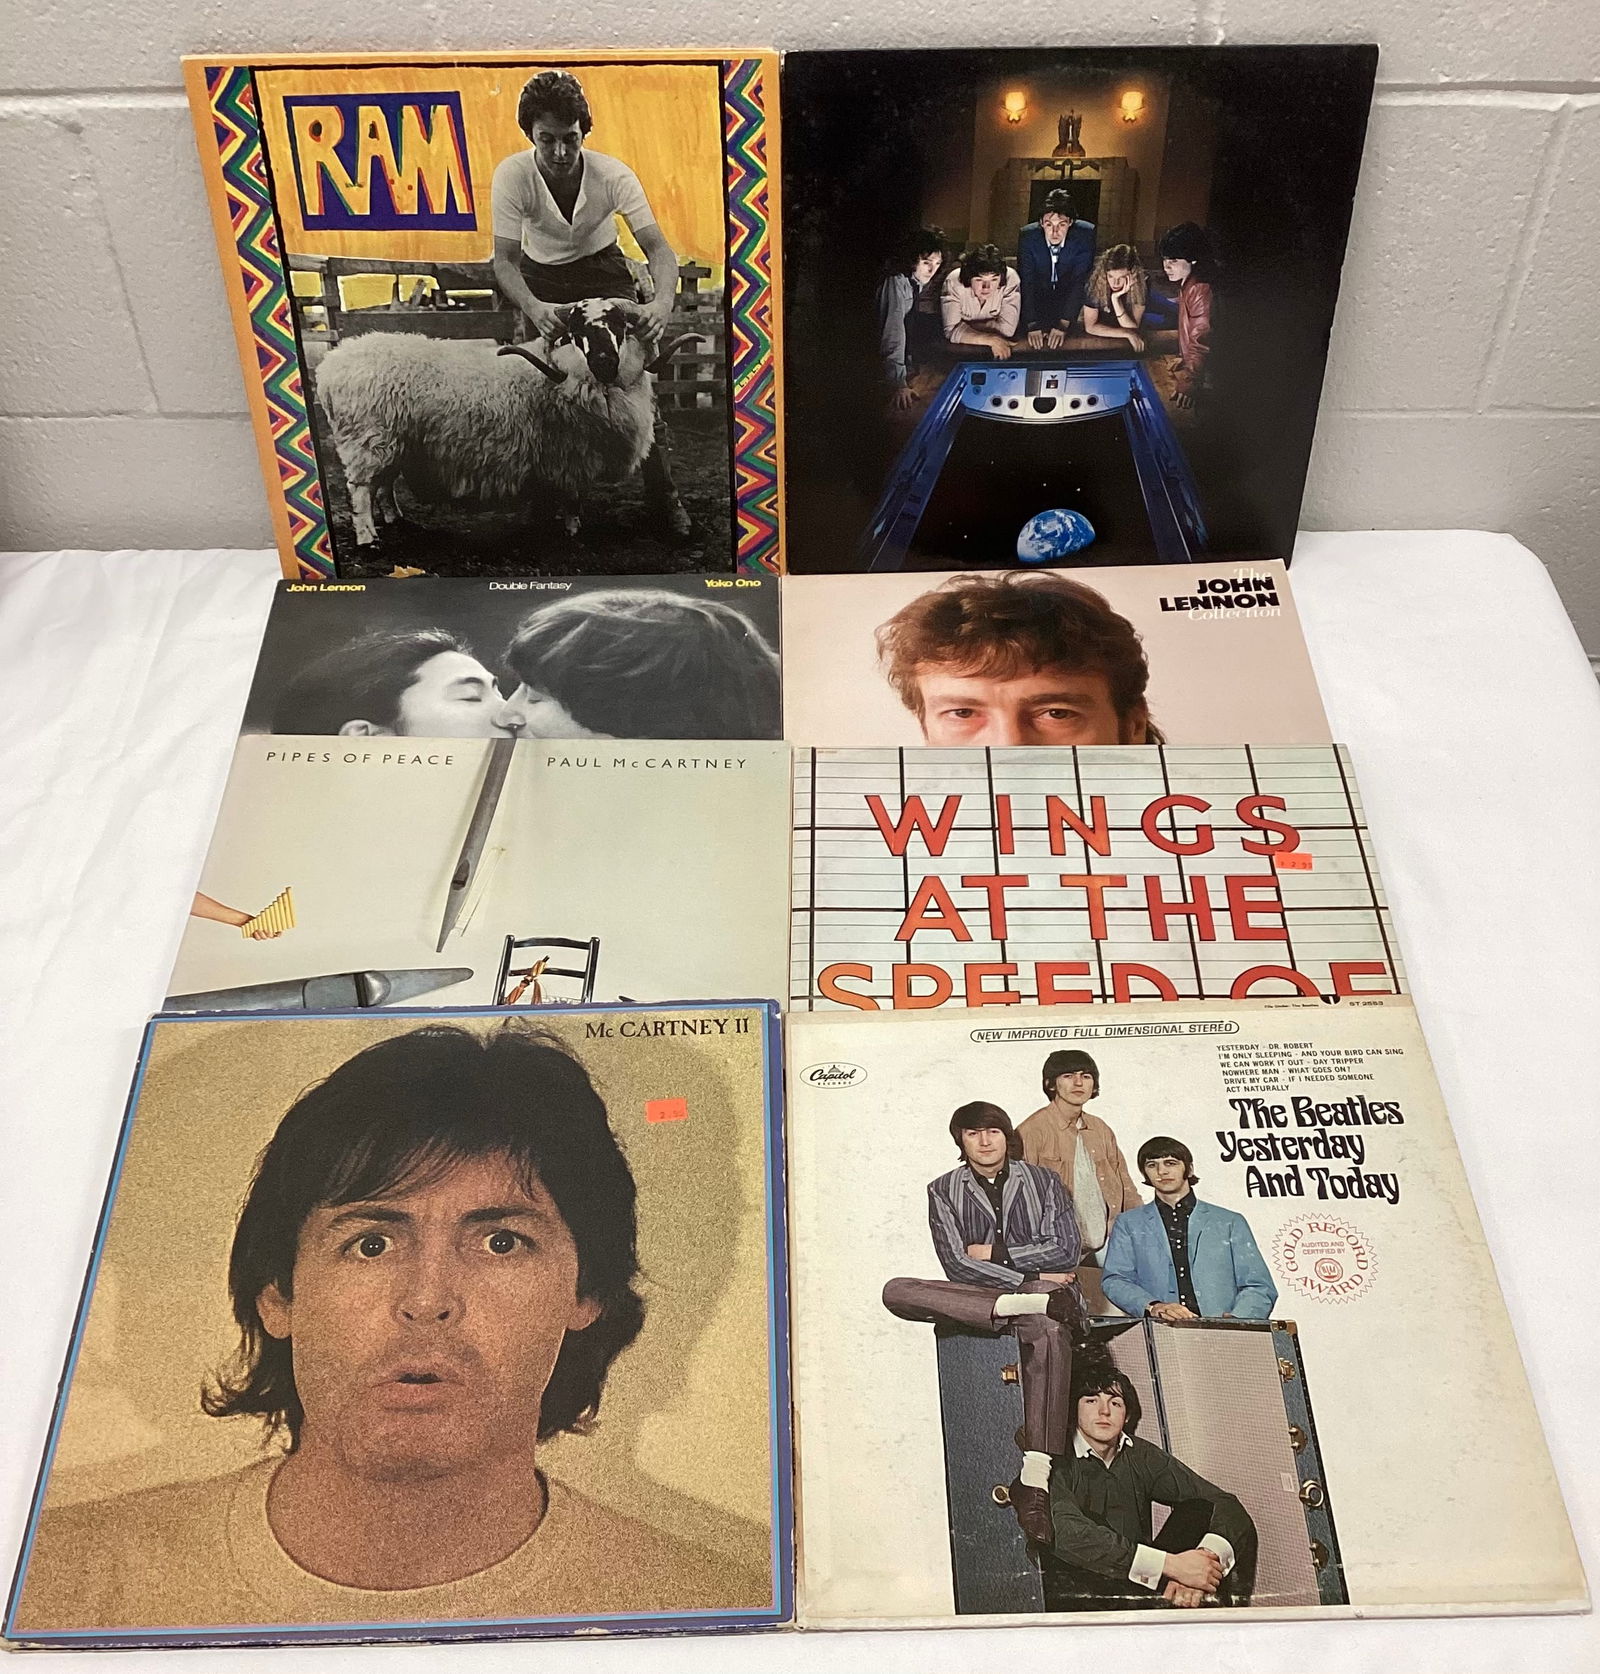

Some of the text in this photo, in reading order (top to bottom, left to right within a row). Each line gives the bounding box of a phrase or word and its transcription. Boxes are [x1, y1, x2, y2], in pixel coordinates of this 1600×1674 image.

[291, 104, 474, 216] RAM
[1233, 567, 1272, 580] The
[286, 583, 366, 592] John Lennon
[489, 581, 572, 591] Double Fantasy
[705, 578, 762, 588] Yoko Ono
[1197, 576, 1276, 594] JOHN
[1160, 592, 1280, 612] LENNON
[1187, 605, 1281, 621] Collection
[266, 751, 454, 766] PIPES OF PEACE
[547, 757, 602, 768] PAUL
[864, 794, 1301, 856] WINGS
[894, 875, 1289, 942] AT THE
[735, 1017, 749, 1034] II
[977, 1022, 1233, 1041] NEW IMPROVED FULL DIMENSIONAL STEREO
[1255, 1051, 1292, 1059] SLEEPING
[1330, 1057, 1364, 1065] TRIPPER
[809, 1068, 857, 1082] Capitol
[1222, 1068, 1260, 1076] NOWHERE
[1224, 1077, 1247, 1085] DRIVE
[1337, 1073, 1375, 1081] SOMEONE
[1243, 1084, 1290, 1092] NATURALLY
[1228, 1094, 1405, 1129] The Beatles
[1215, 1128, 1366, 1165] Yesterday
[1246, 1164, 1400, 1205] And Today
[1283, 1222, 1369, 1272] GOLD RECORD
[1296, 1273, 1364, 1296] AWARD
